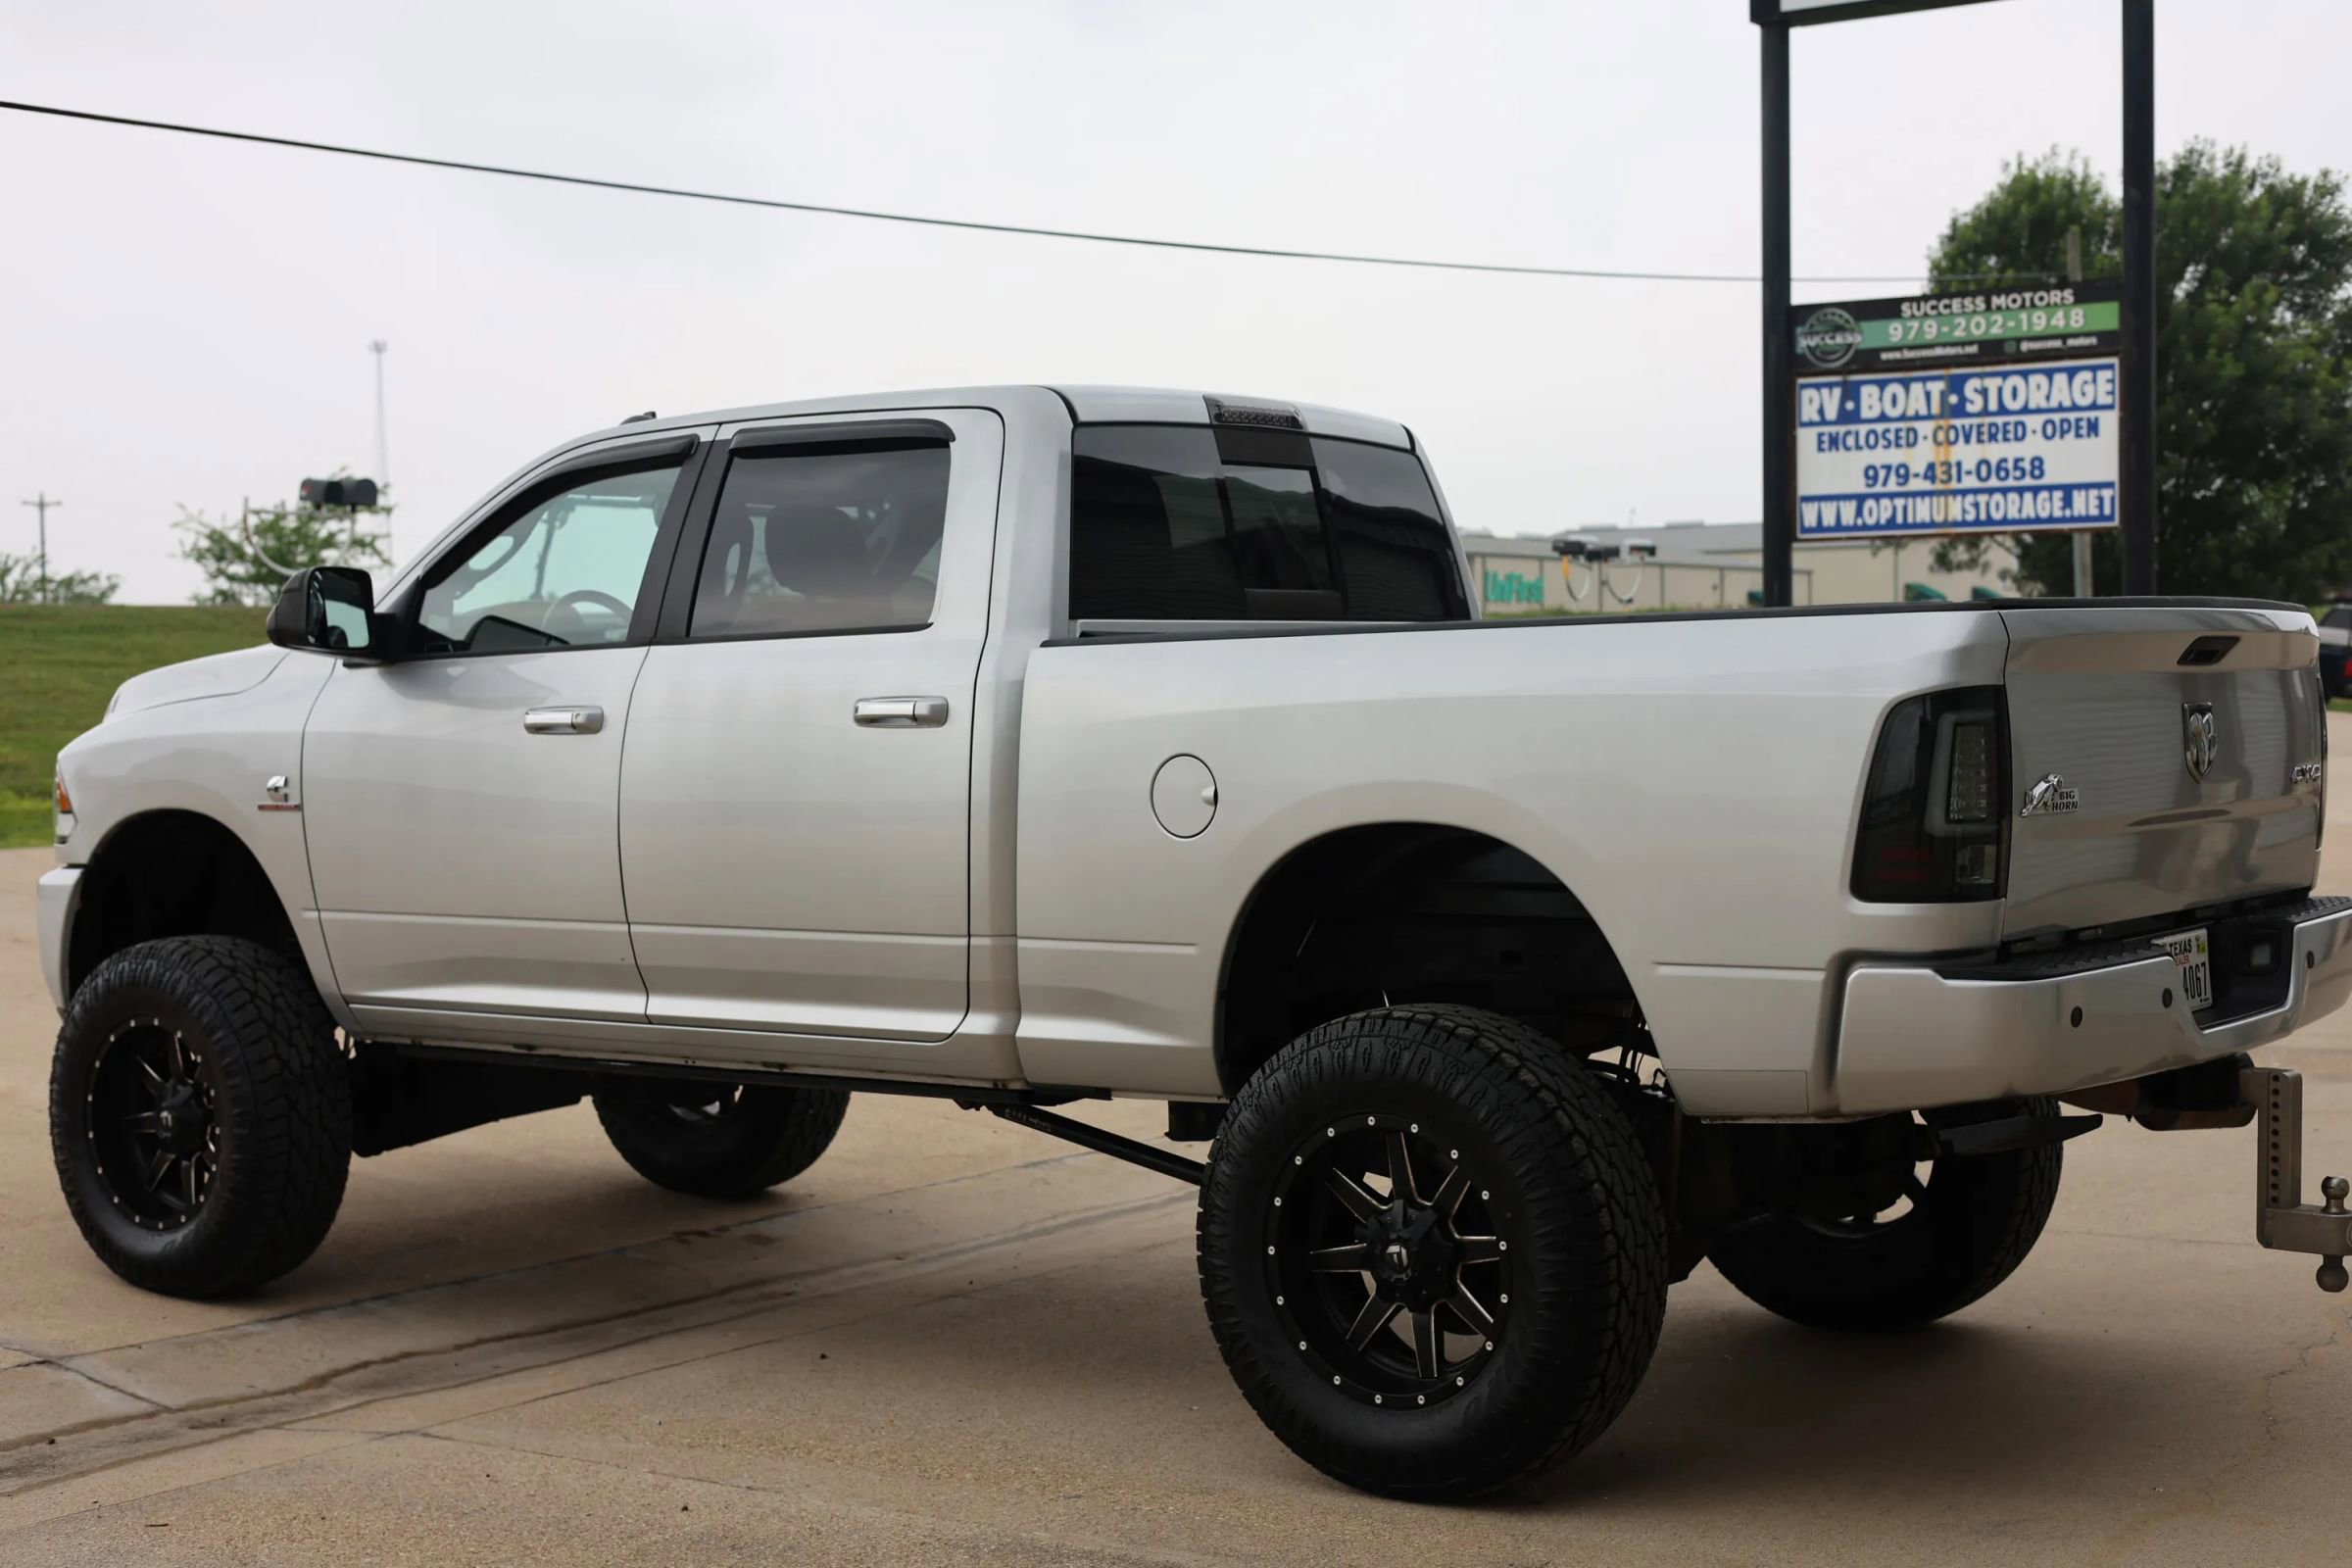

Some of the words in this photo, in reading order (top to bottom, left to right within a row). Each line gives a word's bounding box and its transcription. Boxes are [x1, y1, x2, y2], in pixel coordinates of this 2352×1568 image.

[1900, 299, 1986, 318] SUCCESS
[1990, 288, 2075, 312] MOTORS
[1797, 329, 1862, 347] SUCCESS
[1888, 308, 2086, 342] 979-202-1948
[1800, 386, 1841, 422] RV
[1859, 379, 1945, 419] BOAT
[1964, 369, 2115, 415] STORAGE
[1816, 426, 1918, 453] ENCLOSED
[1933, 420, 2027, 447] COVERED
[2041, 416, 2100, 440] OPEN
[1863, 456, 2045, 489] 979-431-0658
[1800, 488, 2115, 528] WWW.OPTIMUMSTORAGE.NET
[2052, 801, 2078, 811] HORN
[2059, 790, 2076, 801] BIG
[2169, 938, 2192, 956] TEXAS
